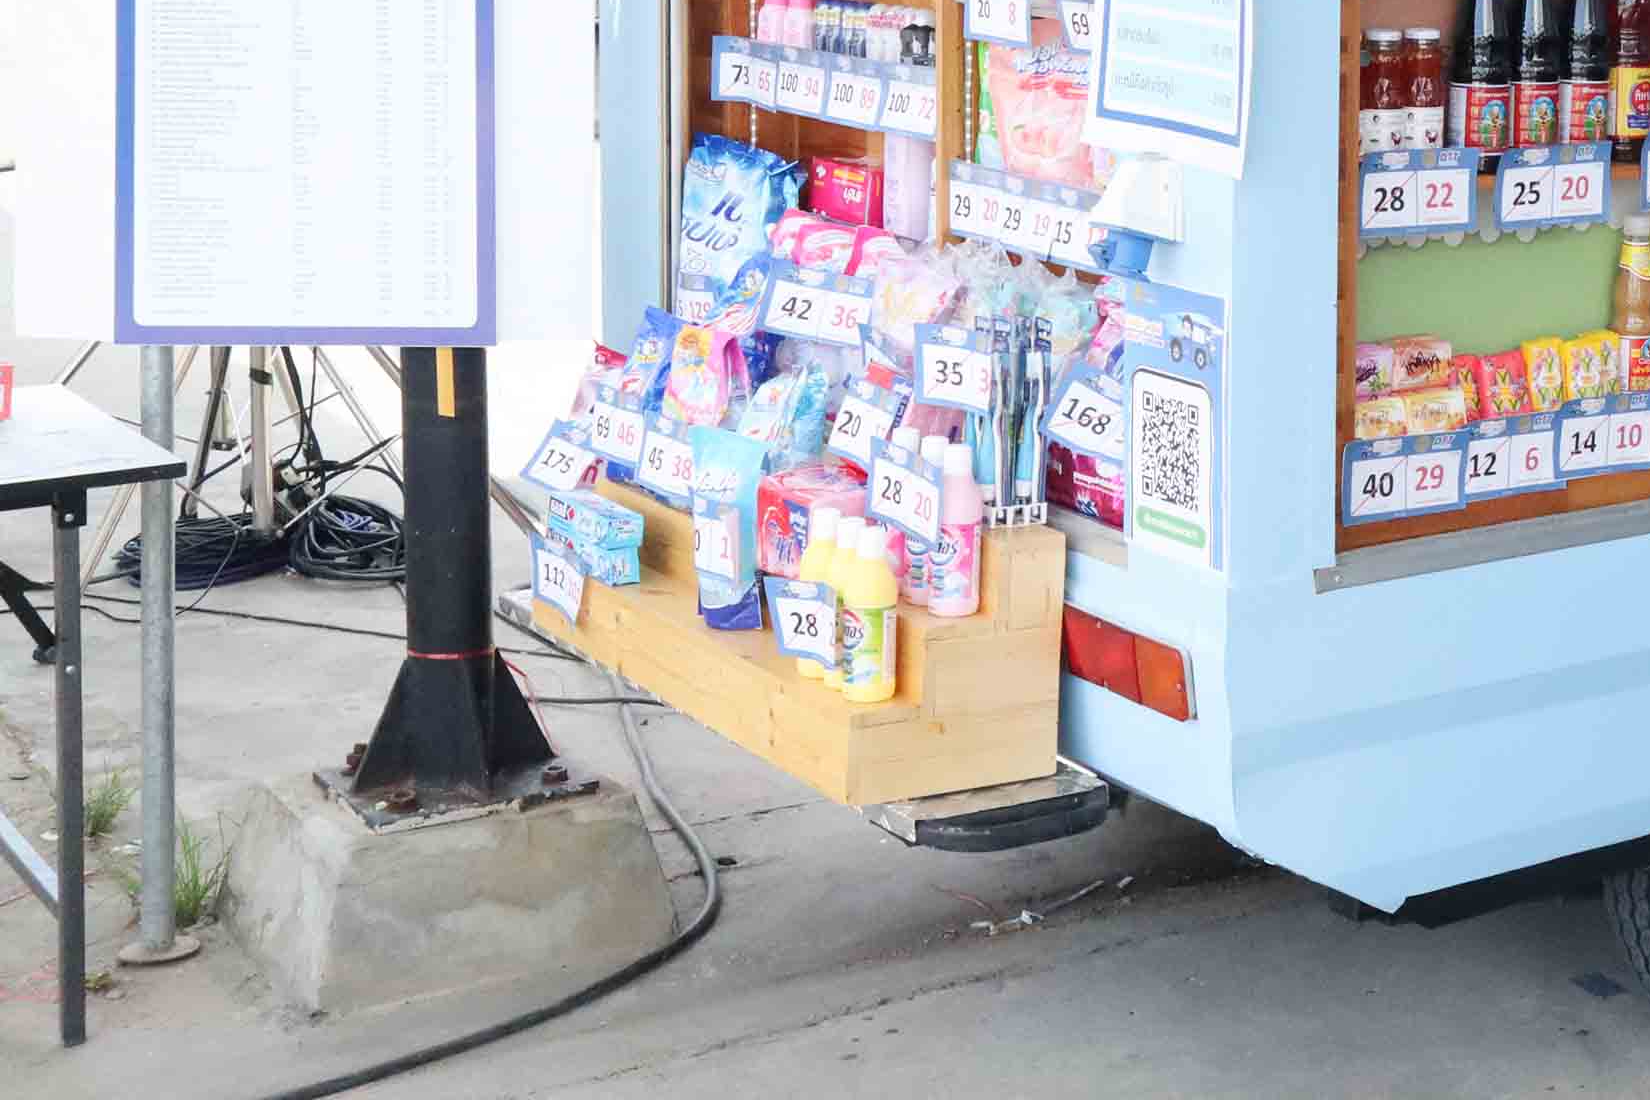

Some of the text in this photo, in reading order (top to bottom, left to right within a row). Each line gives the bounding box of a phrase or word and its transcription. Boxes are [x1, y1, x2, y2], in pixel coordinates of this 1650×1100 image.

[977, 0, 991, 19] 20
[1071, 12, 1090, 36] 69
[731, 64, 750, 85] 73
[781, 72, 799, 93] 100
[833, 83, 853, 104] 100
[888, 93, 911, 113] 100
[1373, 182, 1454, 213] 28 22
[1513, 175, 1590, 207] 25 20
[954, 194, 999, 222] 29 20
[1003, 206, 1021, 231] 29
[1055, 220, 1073, 245] 15
[781, 296, 858, 330] 42 36
[935, 359, 964, 387] 35
[597, 415, 635, 446] 69 46
[837, 410, 862, 438] 20
[1061, 397, 1111, 436] 168
[1570, 423, 1642, 456] 14 10
[541, 447, 574, 474] 175
[648, 446, 693, 481] 45 38
[1469, 447, 1539, 479] 12 6
[1362, 464, 1444, 498] 40 29
[880, 476, 932, 522] 28 20
[543, 563, 565, 590] 112
[789, 611, 819, 638] 28
